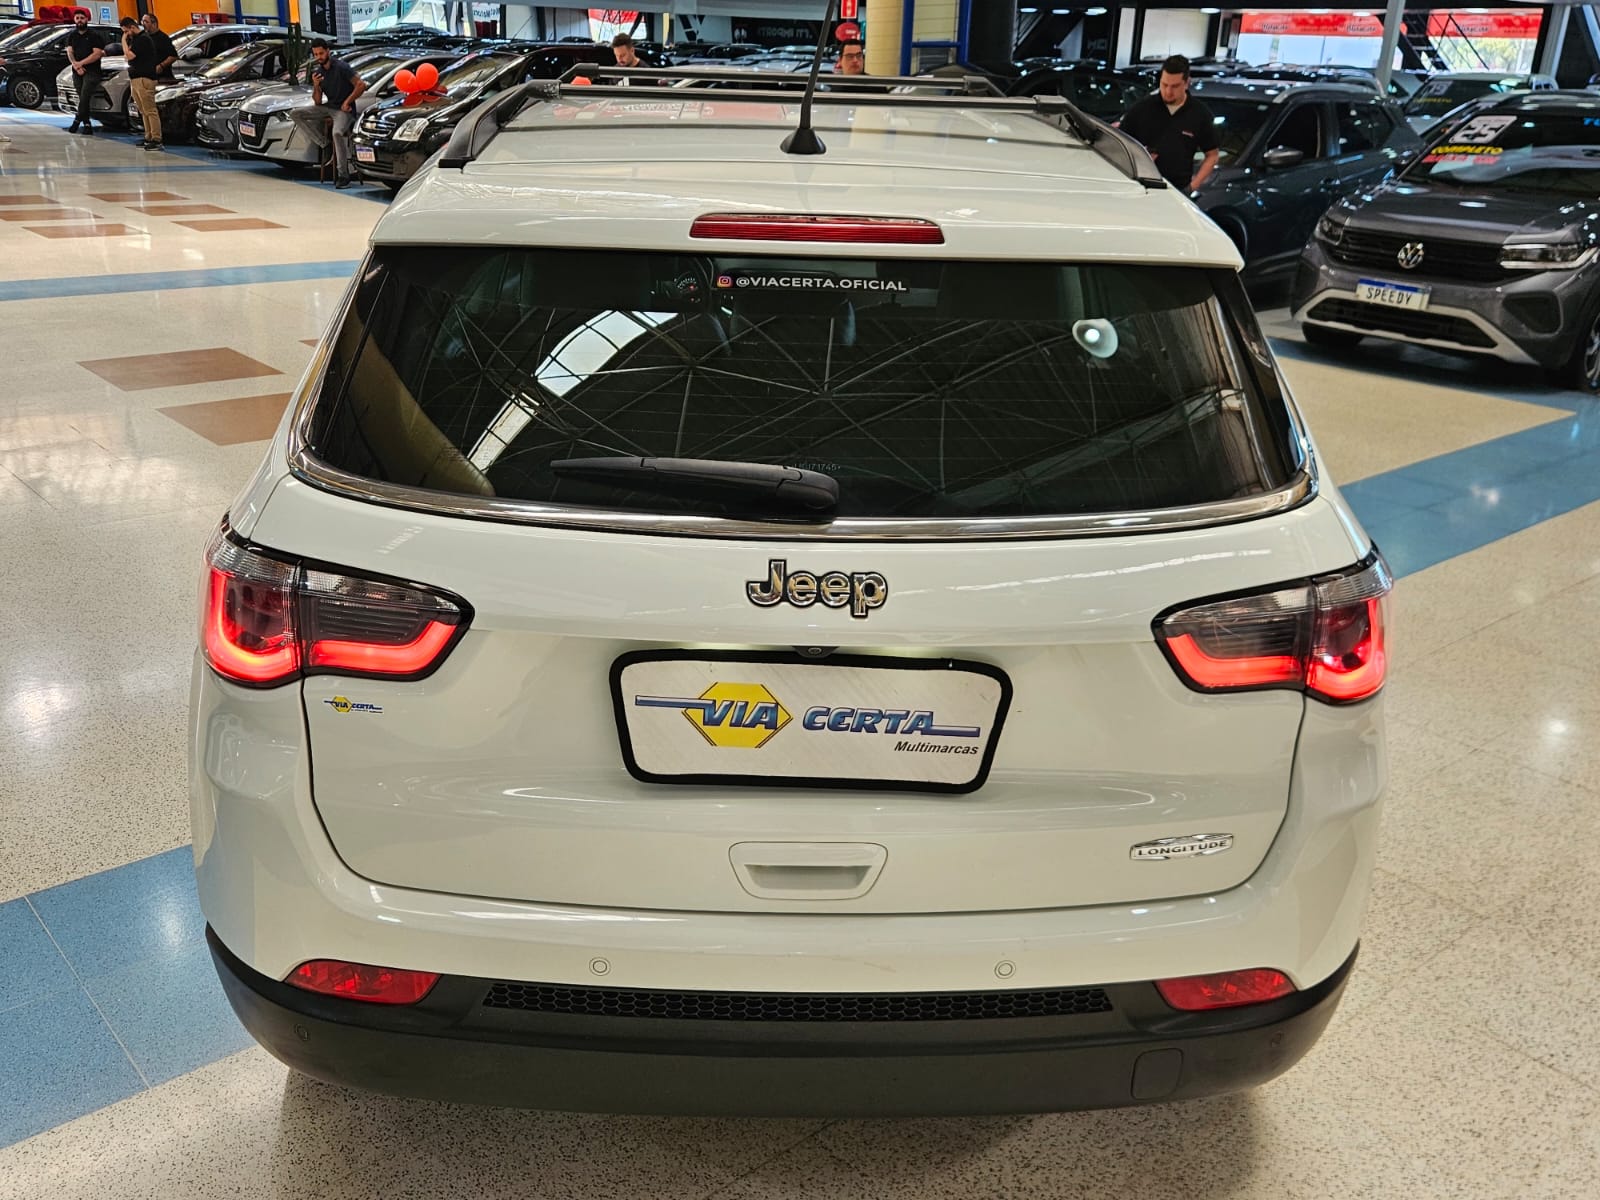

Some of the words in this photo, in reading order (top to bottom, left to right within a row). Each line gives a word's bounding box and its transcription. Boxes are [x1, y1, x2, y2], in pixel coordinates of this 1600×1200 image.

[1431, 145, 1504, 155] COMPLETO
[736, 276, 908, 292] @VIACERTA.OFICIAL
[1366, 287, 1412, 305] SPEEDY
[746, 558, 888, 618] Jeep
[702, 699, 779, 730] VIA
[802, 705, 936, 737] CERTA
[893, 740, 980, 756] Multimarcas
[1137, 839, 1228, 856] LONGITUDE
